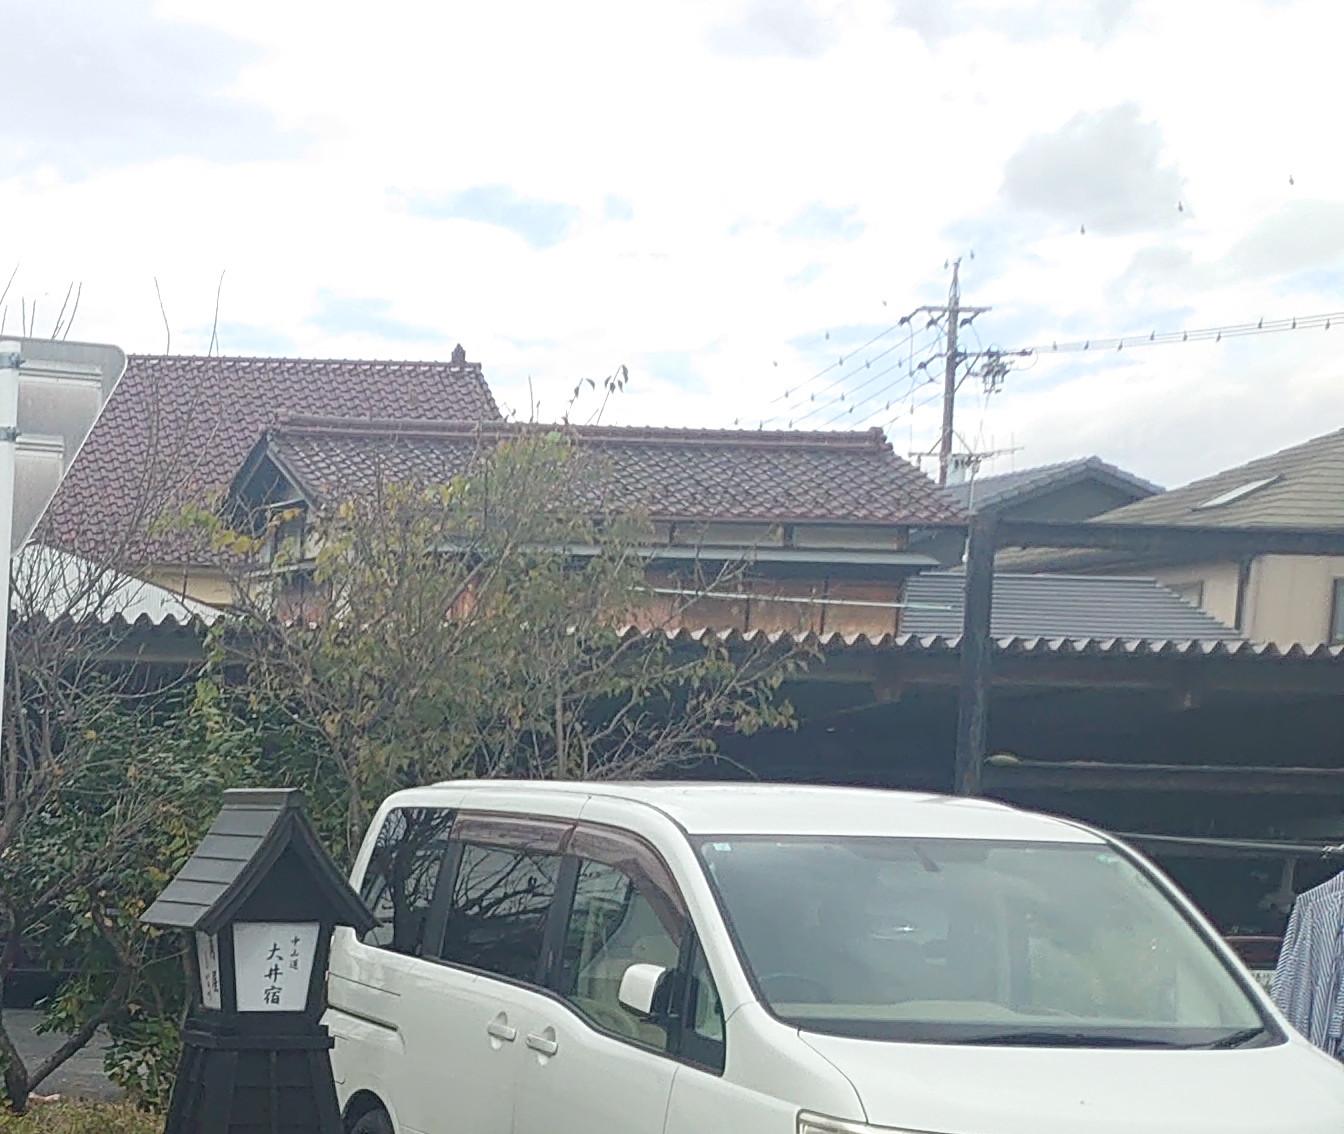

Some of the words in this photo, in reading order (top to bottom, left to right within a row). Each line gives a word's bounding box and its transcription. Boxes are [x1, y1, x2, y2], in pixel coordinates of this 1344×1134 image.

[263, 942, 284, 1005] 大井宿
[289, 935, 301, 970] 中山道
